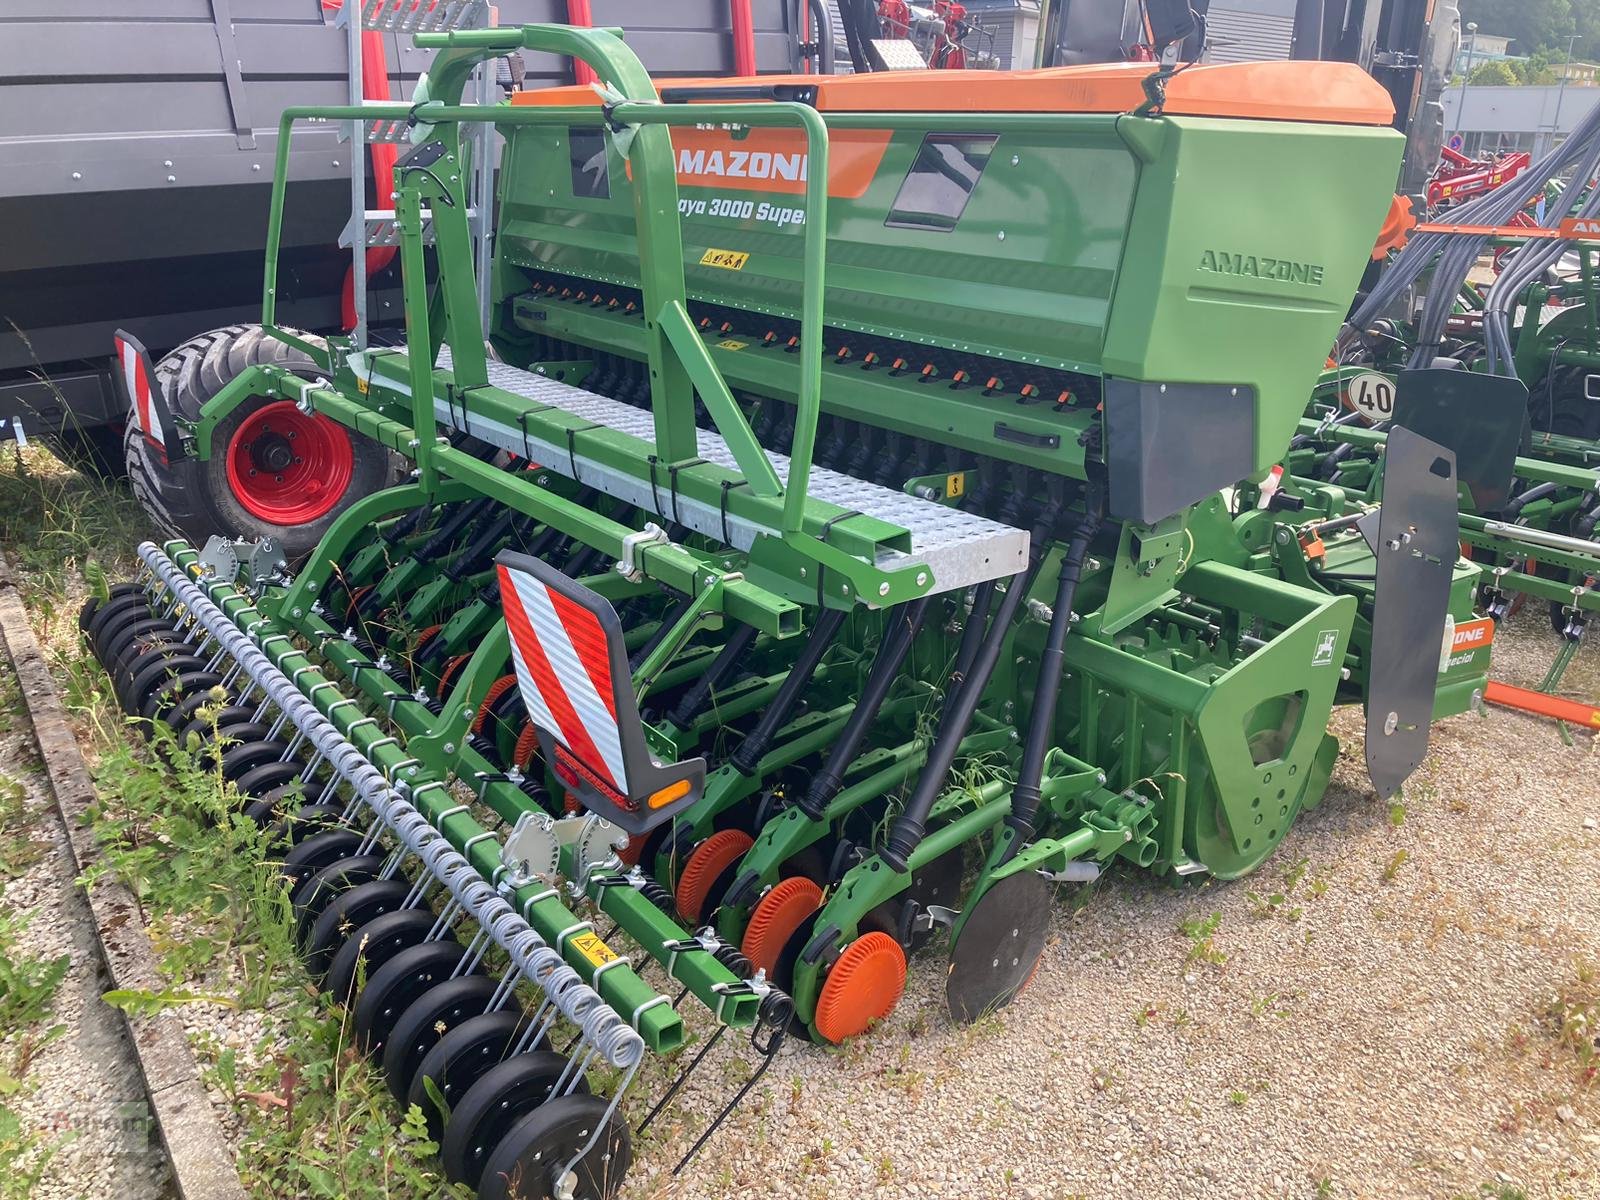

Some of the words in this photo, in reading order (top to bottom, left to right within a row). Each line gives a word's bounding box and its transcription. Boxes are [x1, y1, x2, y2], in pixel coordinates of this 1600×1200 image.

[675, 149, 807, 182] MAZON
[678, 199, 706, 217] aya
[708, 198, 754, 219] 3000
[1572, 222, 1600, 233] AM
[1197, 250, 1324, 286] AMAZONE
[1359, 380, 1391, 413] 40
[1454, 627, 1485, 645] ONE
